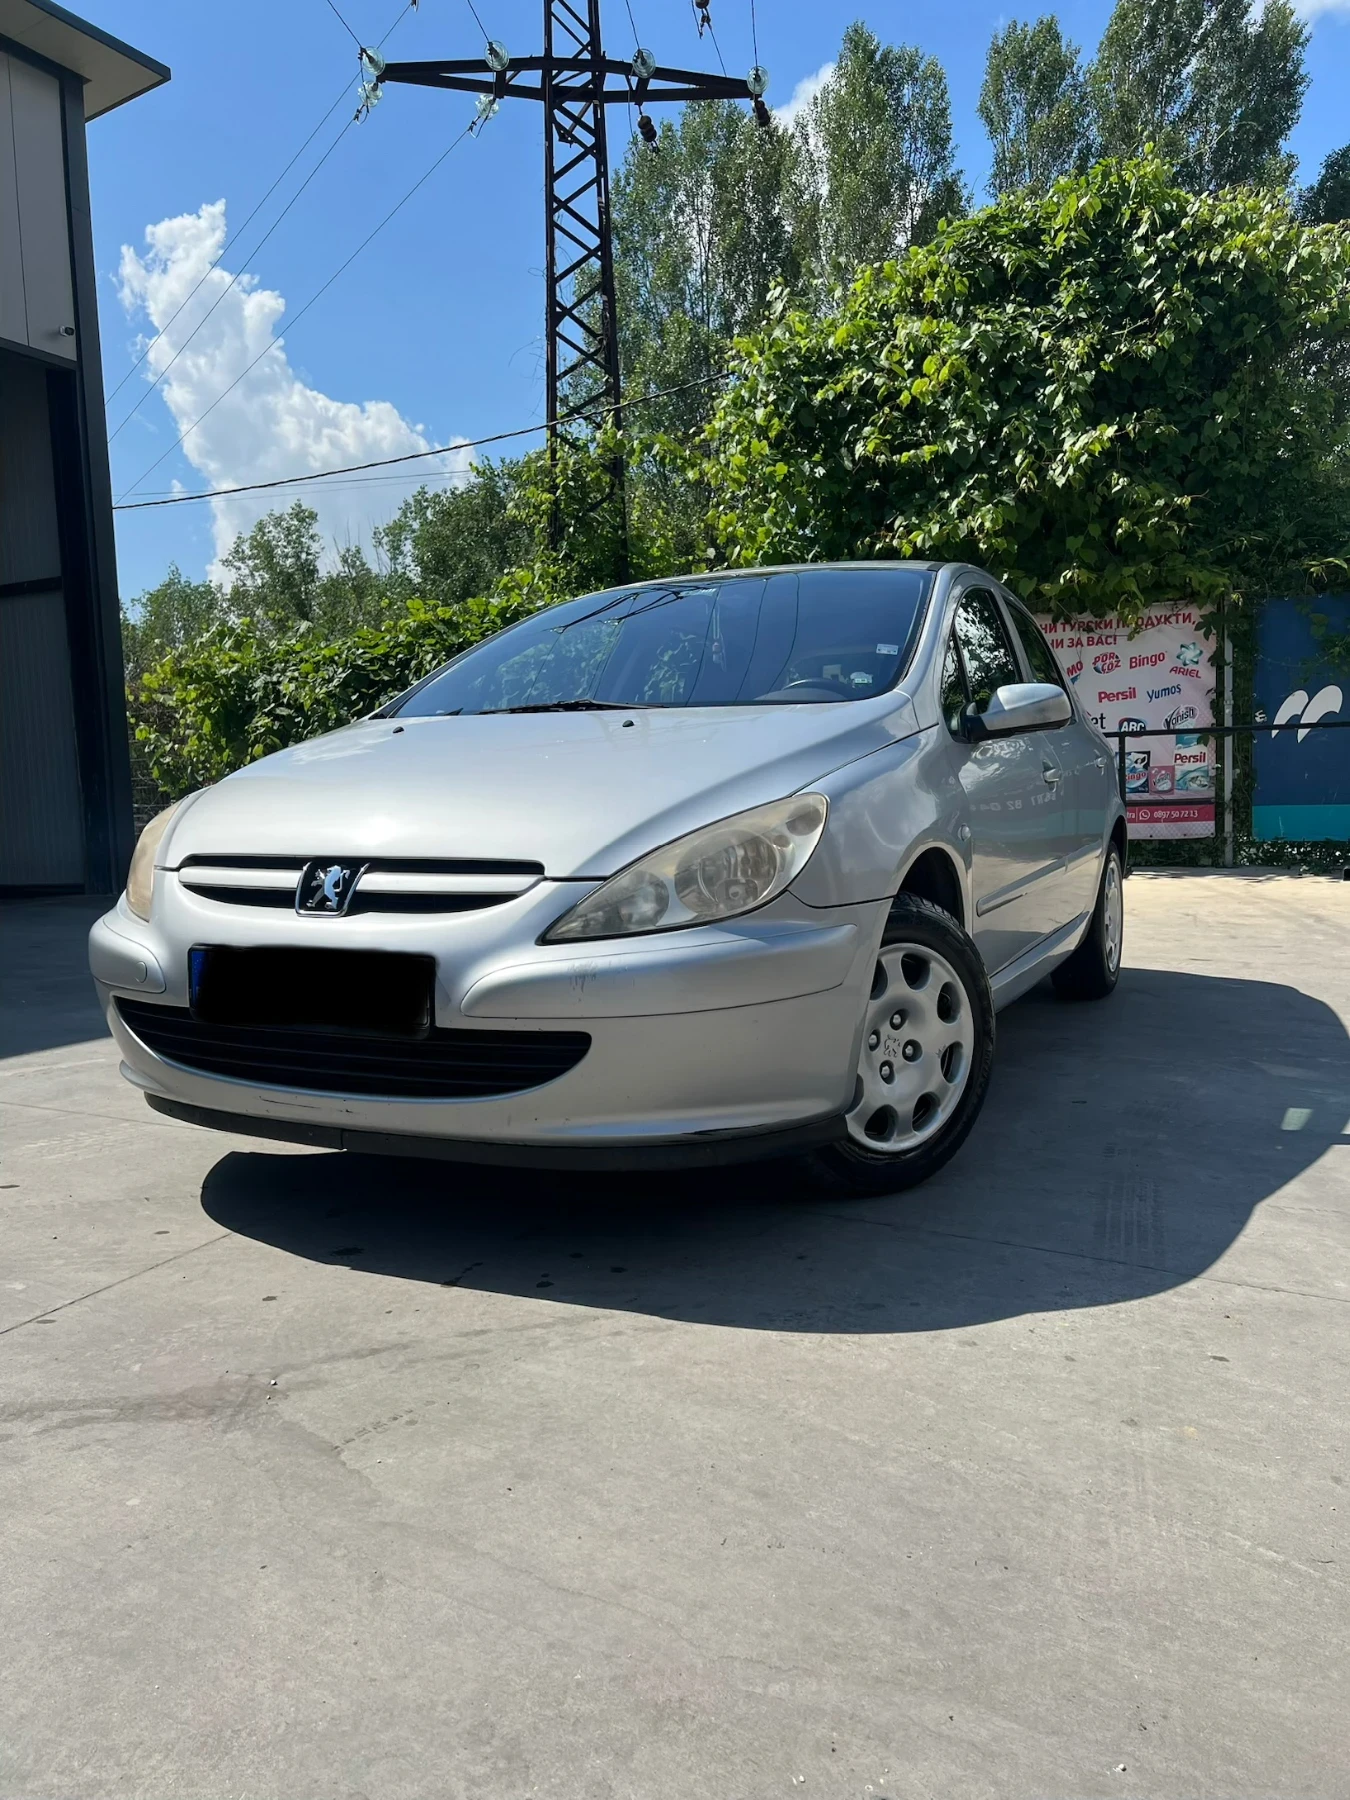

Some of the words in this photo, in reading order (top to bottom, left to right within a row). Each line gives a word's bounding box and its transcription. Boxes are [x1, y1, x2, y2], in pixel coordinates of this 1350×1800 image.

[1060, 618, 1113, 634] ТУРСКИ
[1116, 612, 1197, 630] ПОДУКТИ,
[1067, 636, 1084, 649] ЗА
[1086, 634, 1117, 647] ВАС!
[1129, 652, 1166, 669] Bingo
[1169, 665, 1202, 679] ARIEL
[1098, 686, 1137, 703] Persil
[1164, 705, 1194, 730] Vanish
[1120, 721, 1145, 732] ABC
[1174, 751, 1206, 764] Persil
[1125, 771, 1147, 782] ingo
[1153, 810, 1170, 819] 0897
[1171, 810, 1180, 819] 50
[1180, 810, 1189, 818] 72
[1189, 809, 1199, 818] 13
